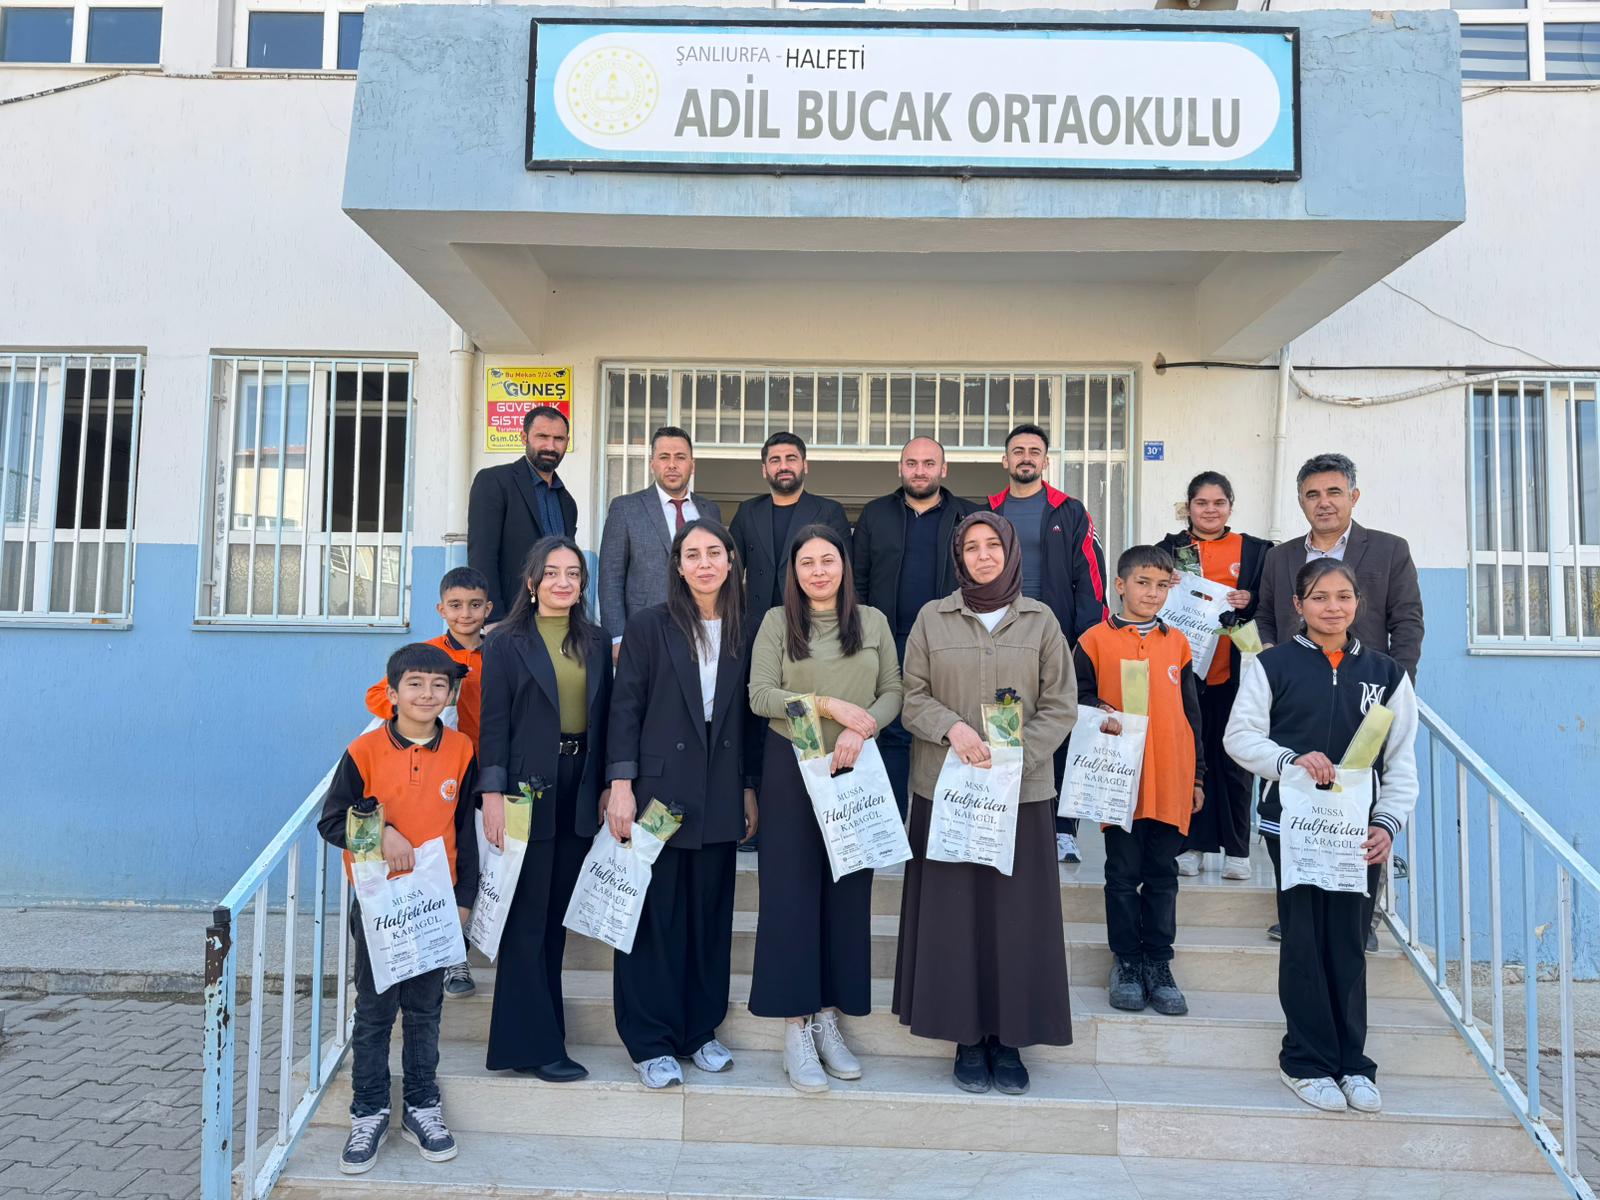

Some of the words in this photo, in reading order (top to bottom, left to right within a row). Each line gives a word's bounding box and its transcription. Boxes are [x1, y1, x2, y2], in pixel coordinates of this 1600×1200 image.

[676, 46, 770, 66] ŞANLIURFA
[786, 44, 865, 70] HALFETİ
[674, 73, 780, 138] ADİL
[797, 89, 953, 142] BUCAK
[967, 93, 1240, 148] ORTAOKULU
[503, 380, 566, 399] GÜNEŞ
[837, 785, 864, 802] MUSSA
[822, 794, 887, 824] Halfeti'den
[1311, 806, 1344, 817] MUSSA
[840, 810, 883, 832] KARAGÜL
[1290, 816, 1366, 836] Halfeti'den
[1304, 836, 1356, 849] KARAGÜL
[391, 889, 424, 907] MUSSA
[373, 897, 446, 931] Halfeti'den
[392, 915, 442, 940] KARAGÜL
